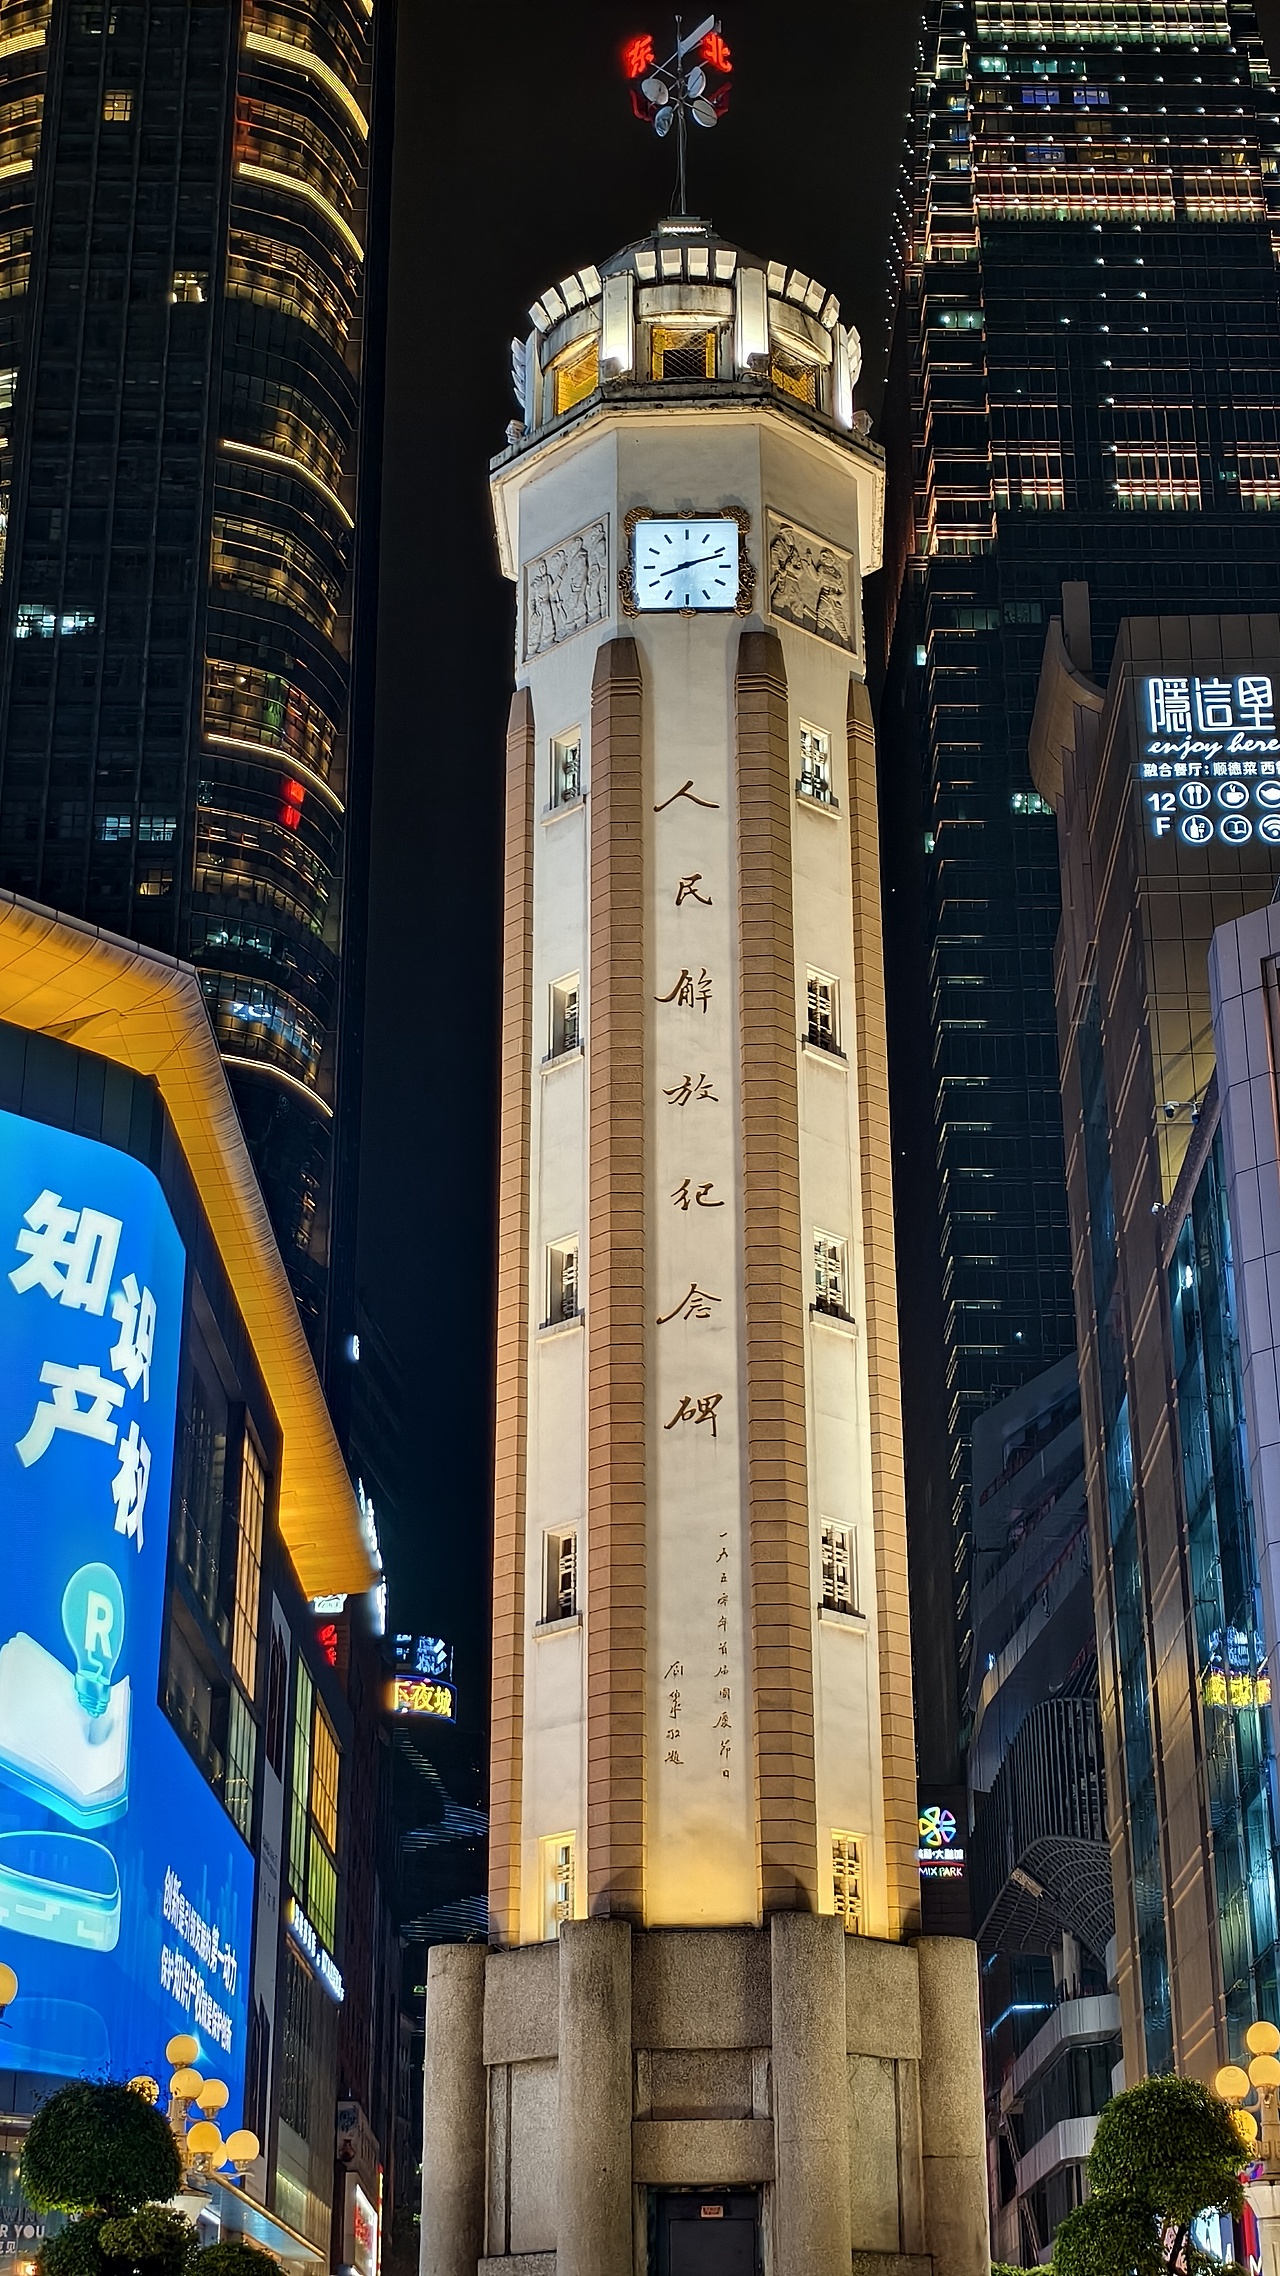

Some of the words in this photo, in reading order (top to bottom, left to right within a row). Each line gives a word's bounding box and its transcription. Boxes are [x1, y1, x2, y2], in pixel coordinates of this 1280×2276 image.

[1148, 734, 1224, 760] enjoy
[1227, 731, 1280, 753] here
[1148, 792, 1177, 812] 12
[1156, 816, 1171, 836] F
[85, 1590, 114, 1659] R
[939, 1867, 963, 1877] PARK
